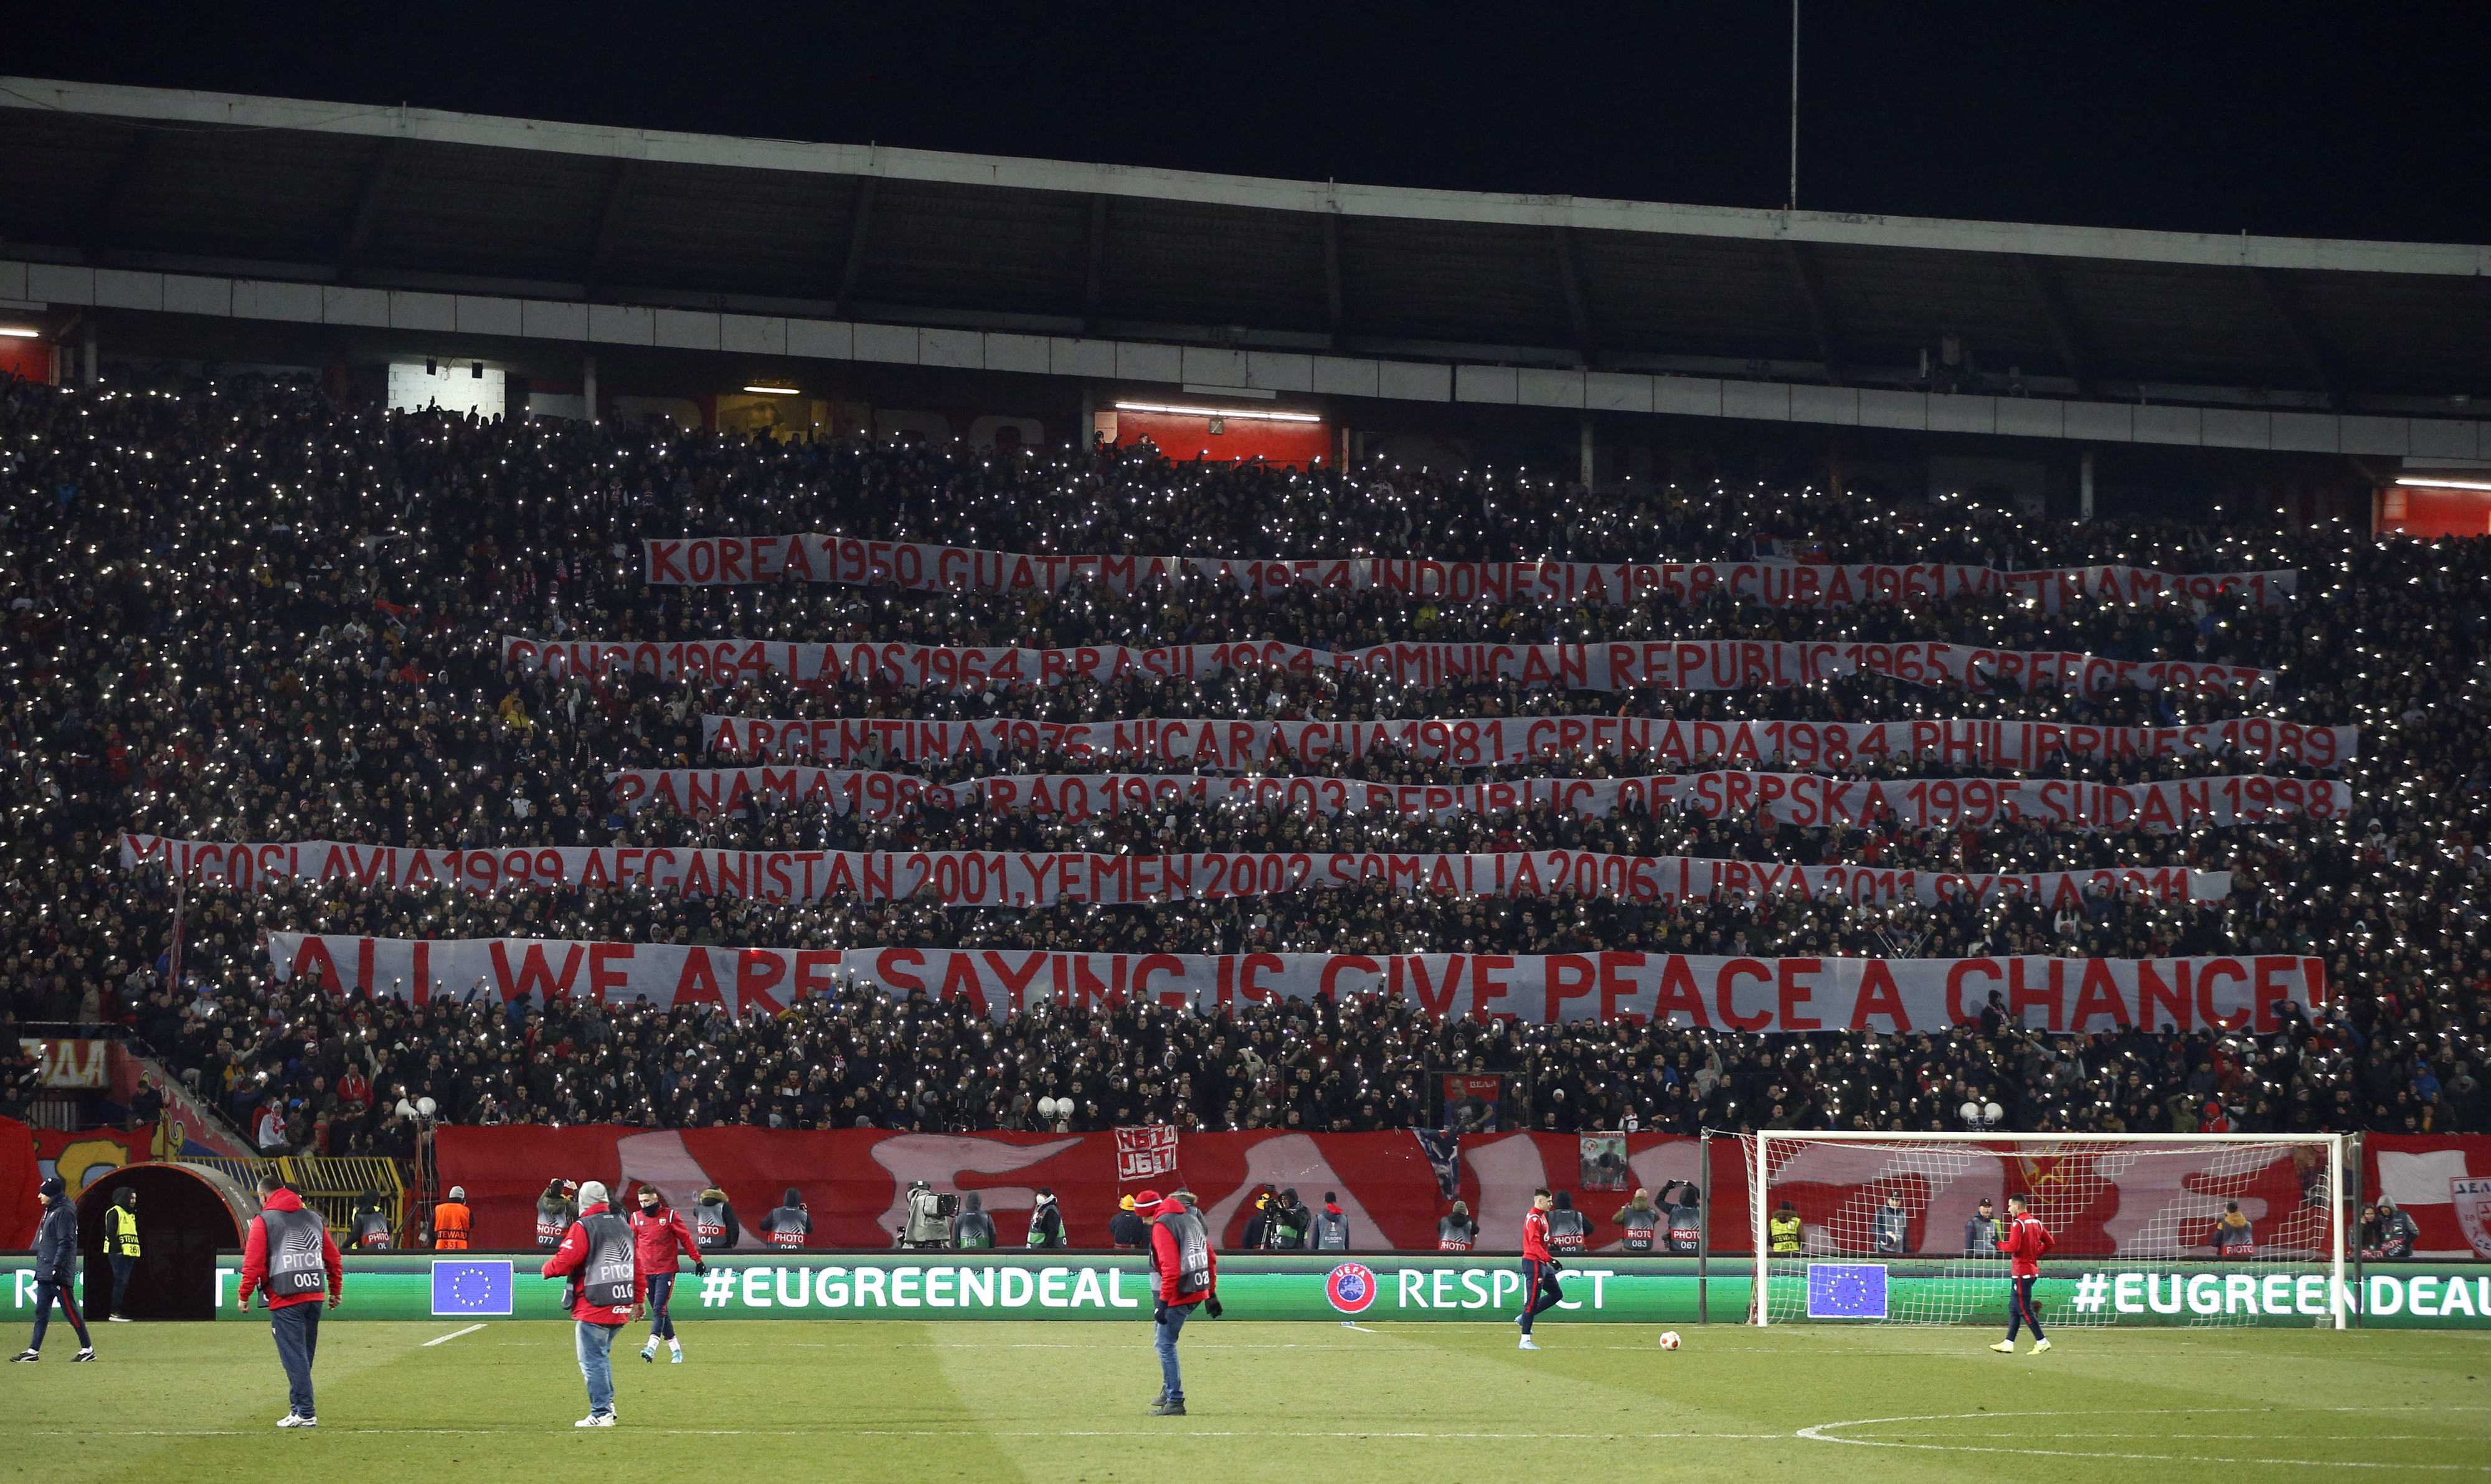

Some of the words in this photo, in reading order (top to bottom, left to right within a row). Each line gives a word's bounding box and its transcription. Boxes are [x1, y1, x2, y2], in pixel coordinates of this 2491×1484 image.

[651, 535, 811, 584] KOREA
[1371, 560, 1612, 603] INDONESIA
[1731, 564, 1853, 608] CUBA
[1610, 643, 1838, 689] REPUBLIC
[714, 719, 981, 765] ARGENTINA
[1696, 773, 1889, 828] SRPSKA
[582, 848, 893, 904] AFGANISTAN
[1019, 853, 1192, 904] YEMEN
[489, 940, 635, 1013] WE
[672, 945, 842, 1021] ARE
[876, 947, 1186, 1021] SAYING
[1217, 953, 1284, 1020] IS
[1544, 951, 1822, 1032] PEACE
[1849, 959, 1912, 1032] A
[1945, 956, 2325, 1033] CHANCE!
[538, 1235, 554, 1244] 077
[774, 1234, 803, 1243] PHOTO
[1554, 1235, 1582, 1244] PHOTO
[282, 1252, 322, 1269] PITCH
[294, 1272, 319, 1287] 003
[1335, 1265, 1366, 1278] UEFA
[700, 1267, 1138, 1308] #EUGREENDEAL
[1399, 1269, 1614, 1310] RESPCT
